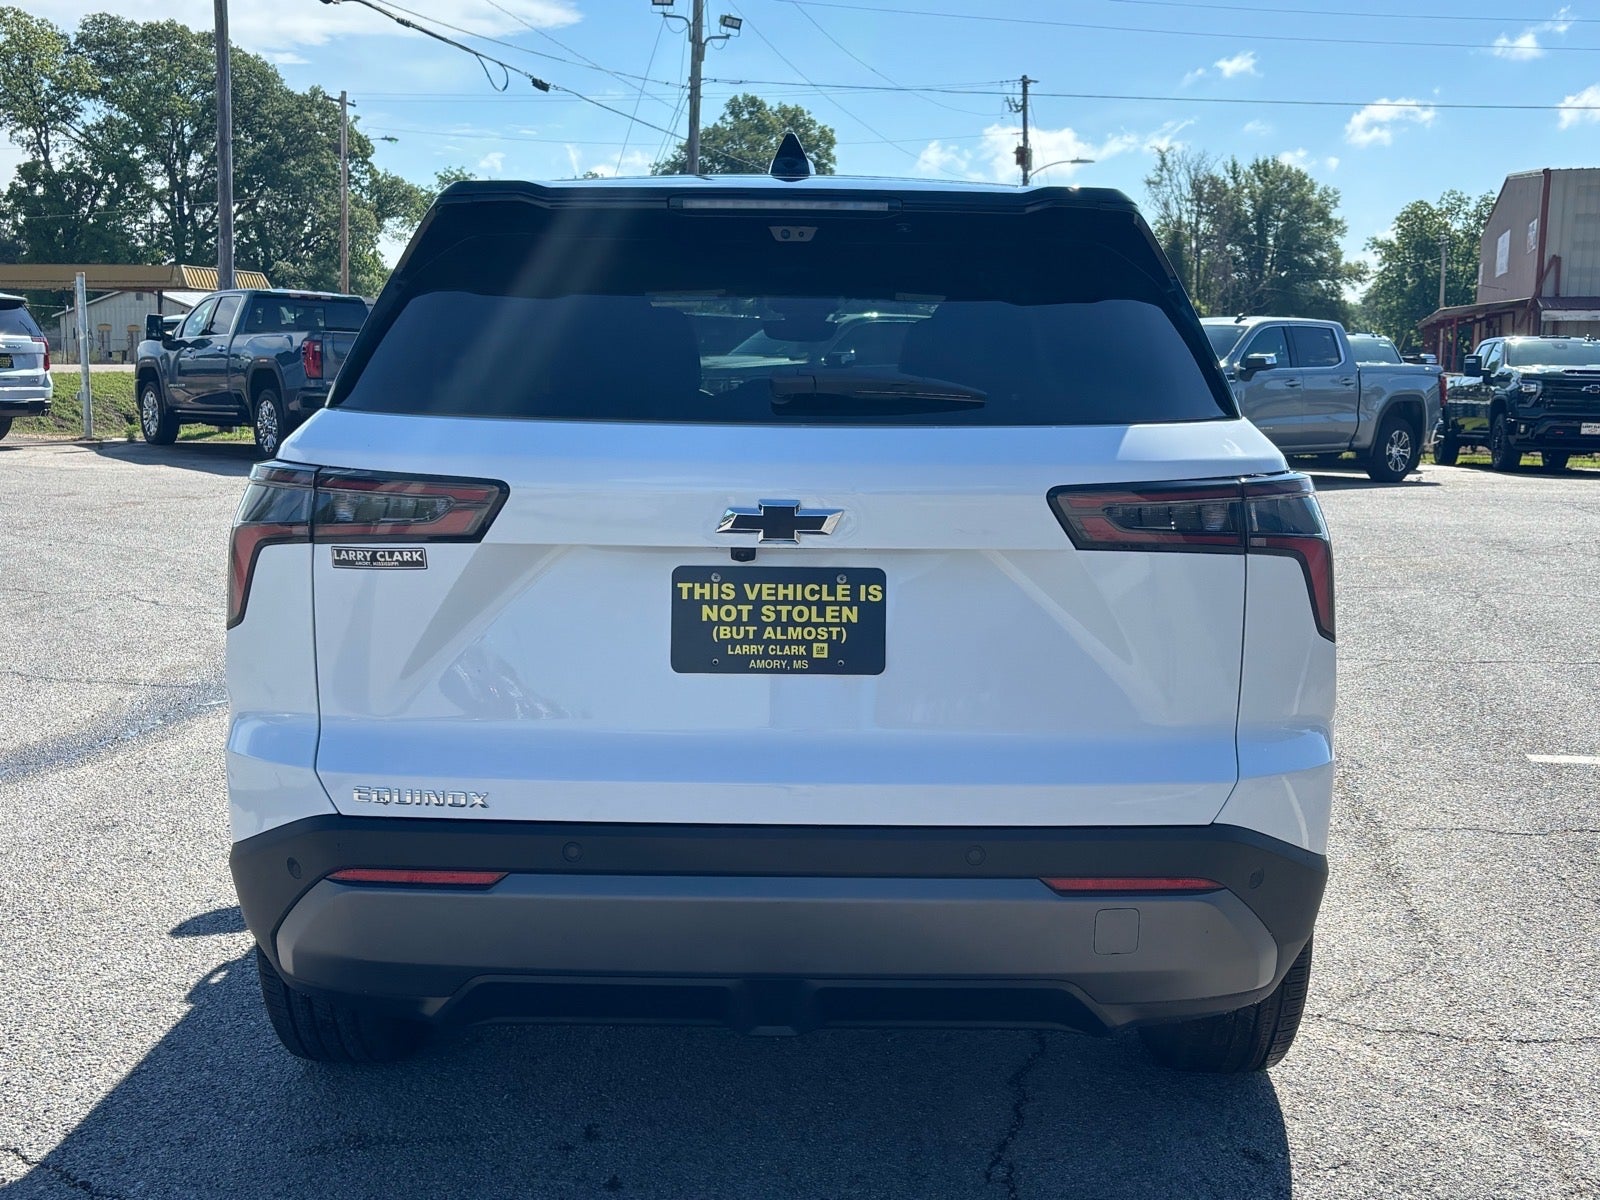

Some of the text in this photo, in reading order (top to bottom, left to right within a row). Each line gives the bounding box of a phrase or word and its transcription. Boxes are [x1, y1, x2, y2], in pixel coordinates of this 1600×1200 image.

[334, 550, 423, 561] LARRY CLARK
[677, 582, 883, 602] THIS VEHICLE IS
[701, 604, 858, 623] NOT STOLEN
[712, 626, 848, 643] (BUT ALMOST)
[727, 644, 807, 655] LARRY CLARK
[749, 659, 809, 670] AMORY, MS
[352, 785, 490, 808] EQUINOX
